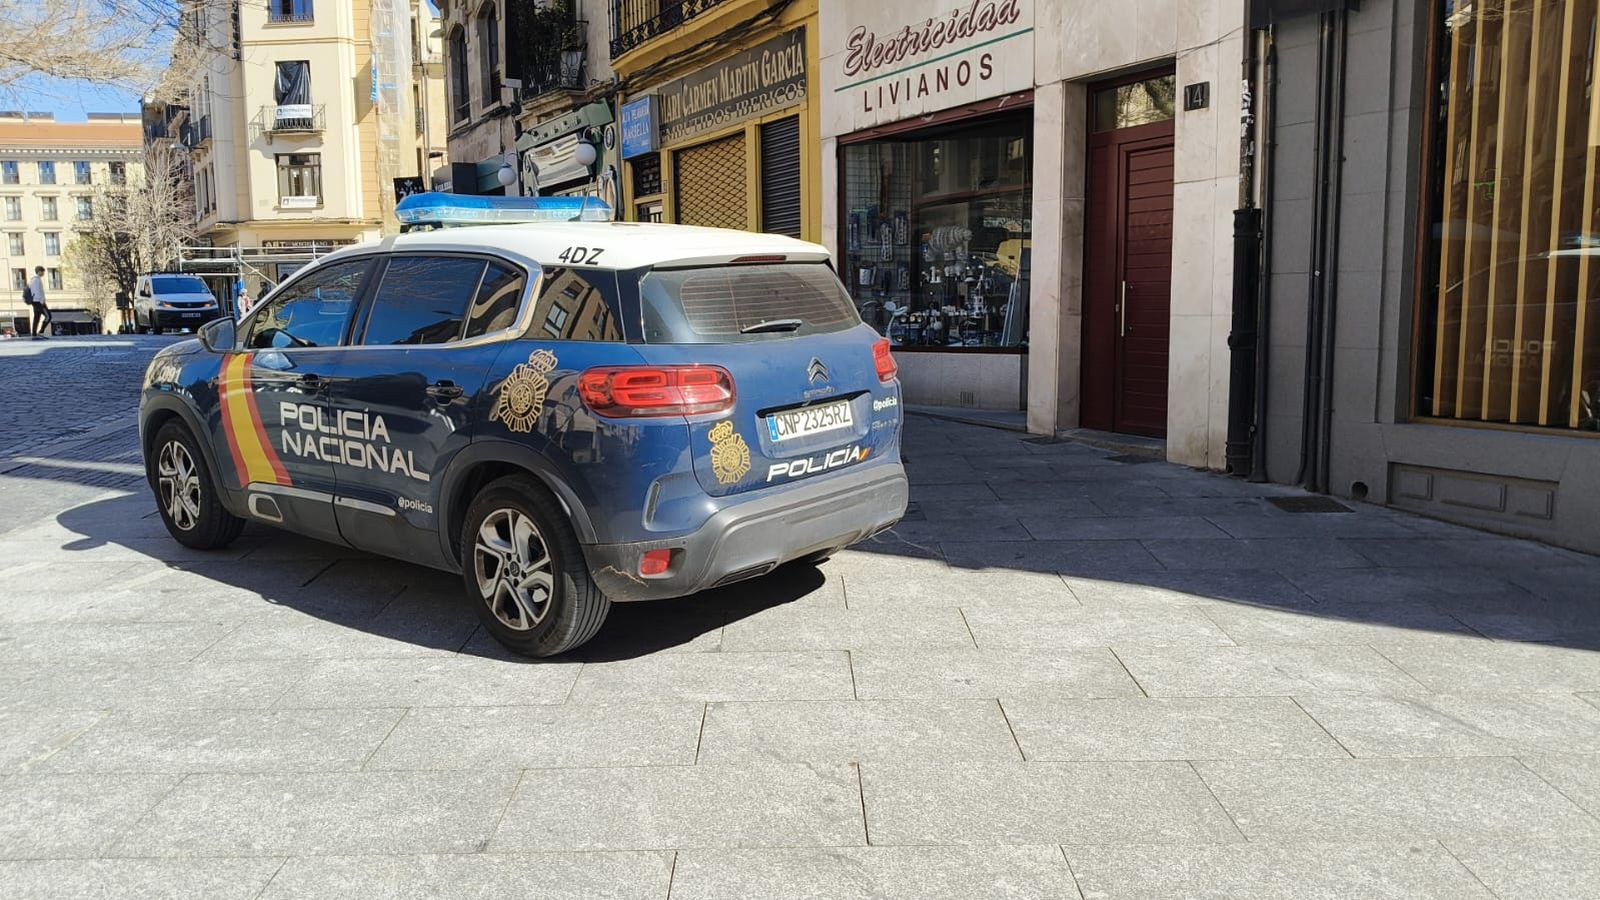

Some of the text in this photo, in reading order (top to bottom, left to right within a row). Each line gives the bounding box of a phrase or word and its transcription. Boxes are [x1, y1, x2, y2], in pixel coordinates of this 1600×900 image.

[843, 0, 1020, 77] Electricidad
[682, 77, 719, 117] CARMEN
[719, 53, 760, 102] MARTÍN
[761, 34, 805, 87] GARCÍA
[864, 53, 993, 112] LIVIANOS
[1186, 85, 1203, 108] 14
[660, 106, 733, 144] EMBUTIDOS
[558, 246, 605, 265] 4DZ
[280, 401, 391, 443] POLICÍA
[775, 412, 801, 436] CNP
[804, 402, 851, 432] 2325RZ
[281, 429, 430, 482] NACIONAL
[766, 445, 860, 482] POLICÍA
[398, 496, 433, 514] @policia
